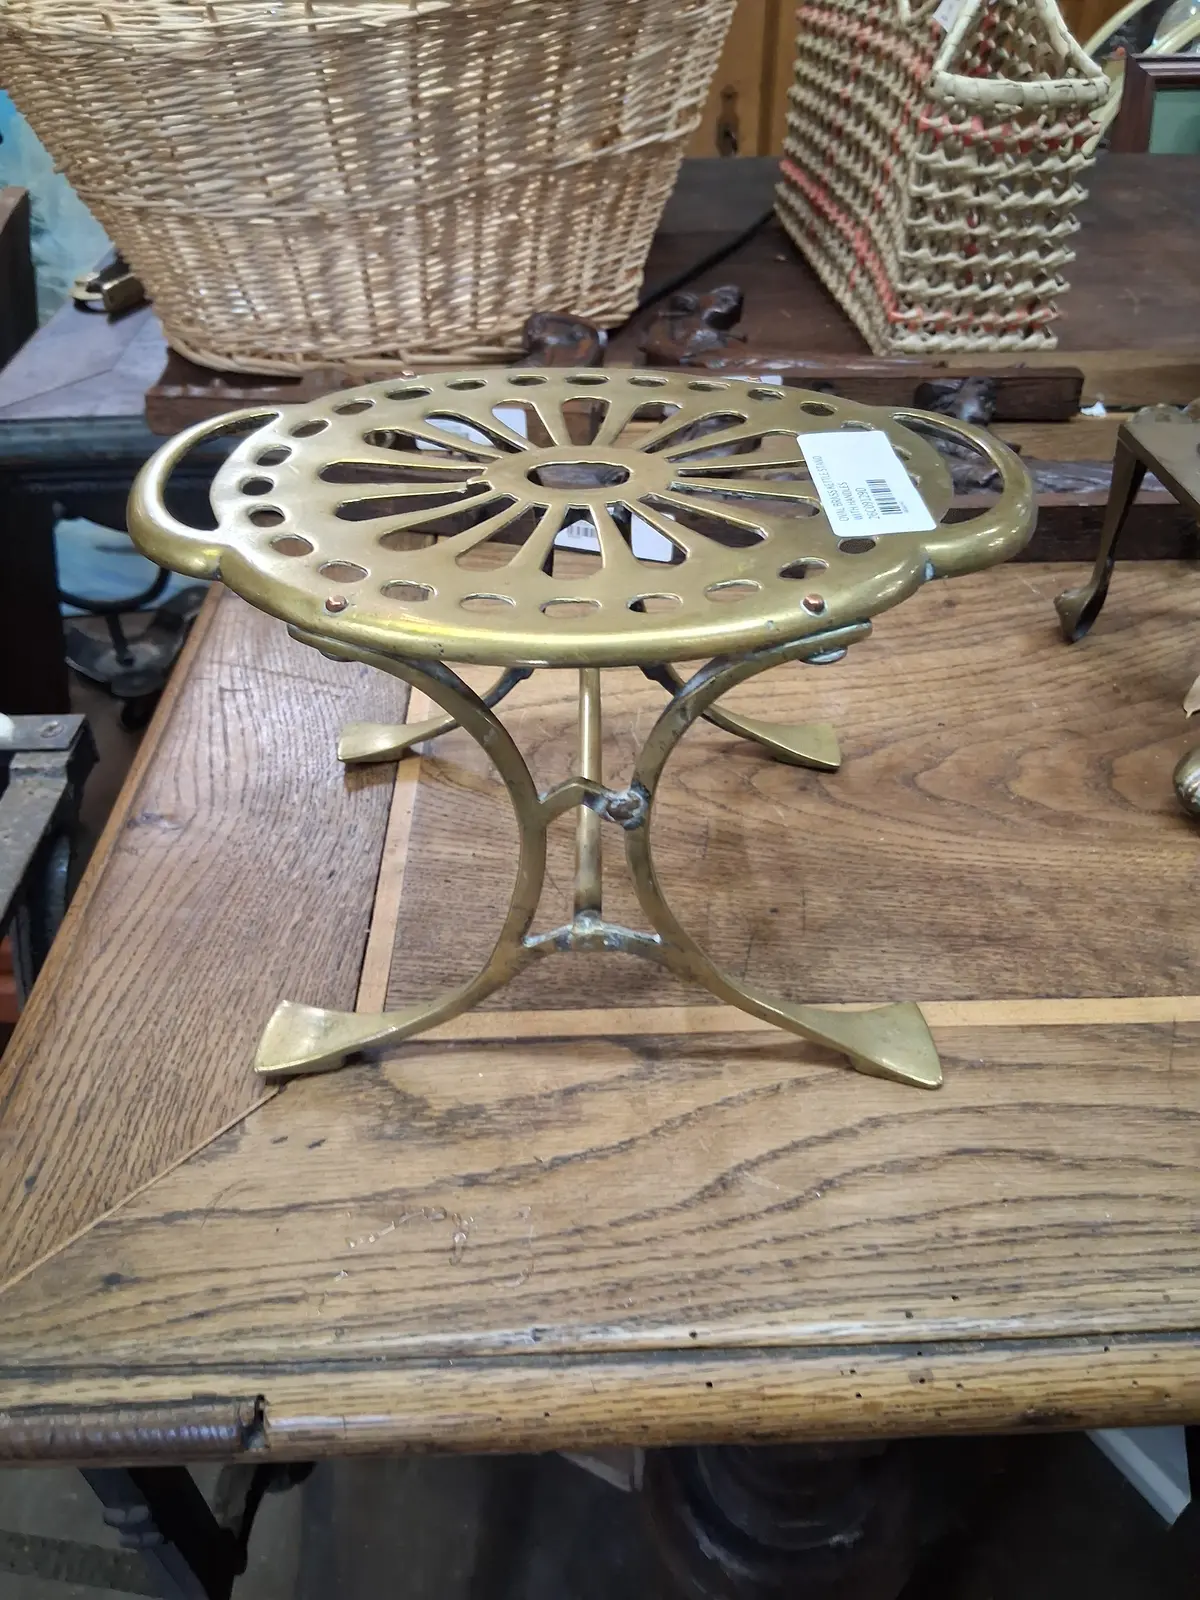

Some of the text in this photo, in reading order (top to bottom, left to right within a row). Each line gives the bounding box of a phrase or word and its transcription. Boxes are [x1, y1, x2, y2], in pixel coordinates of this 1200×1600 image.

[812, 455, 827, 471] STAND
[828, 489, 843, 506] BRASS
[838, 482, 863, 520] WITH HANDLES
[835, 507, 850, 521] OVAL
